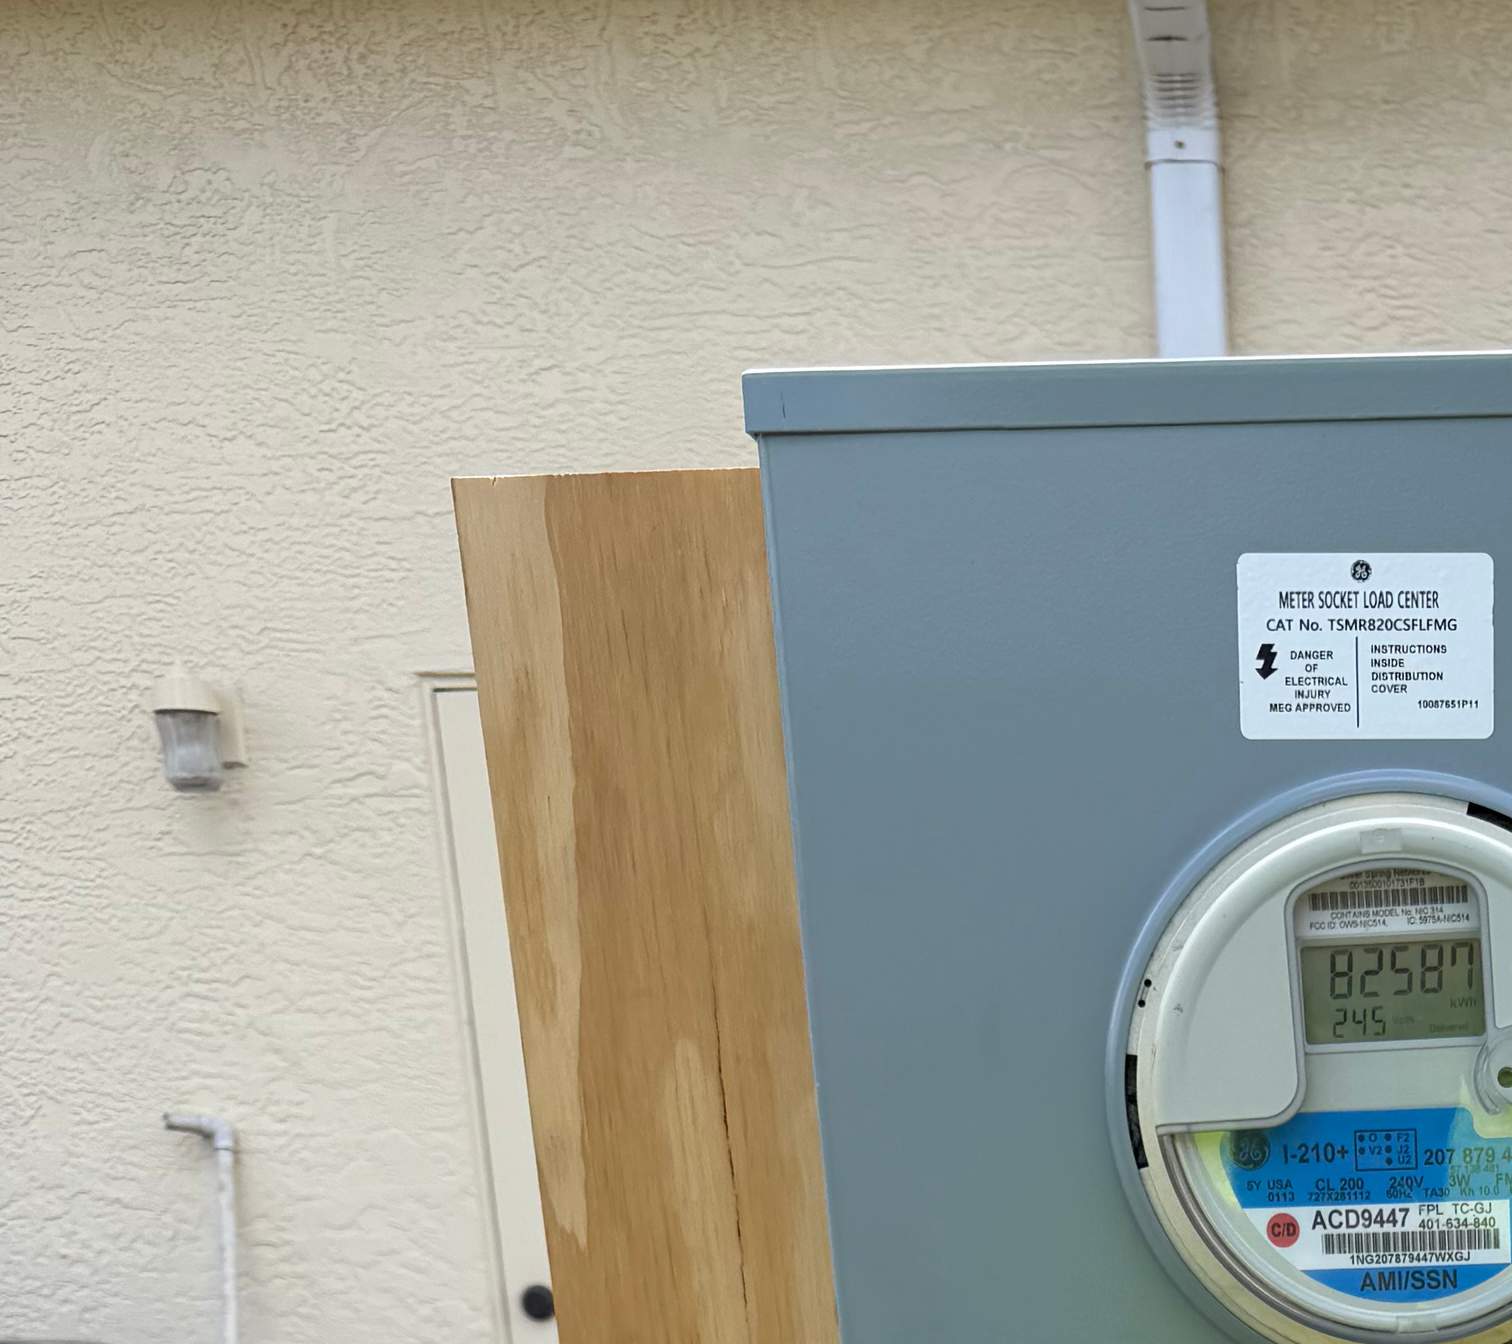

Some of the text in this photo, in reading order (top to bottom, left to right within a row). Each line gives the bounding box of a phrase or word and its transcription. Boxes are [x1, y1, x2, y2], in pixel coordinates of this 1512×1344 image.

[1278, 591, 1440, 609] METER SOCKET LOAD CENTER
[1266, 618, 1458, 632] CAT No. TSMR820CSFLFMG
[1290, 650, 1333, 660] DANGER
[1370, 644, 1447, 654] INSTRUCTIONS
[1305, 664, 1318, 673] OF
[1370, 658, 1405, 668] INSIDE
[1285, 676, 1348, 686] ELECTRICAL
[1371, 672, 1443, 681] DISTRIBUTION
[1294, 690, 1331, 699] INJURY
[1371, 685, 1408, 694] COVER
[1269, 703, 1351, 713] MEG APPROVED
[1329, 941, 1474, 1000] 82587
[1332, 1006, 1386, 1038] 245
[1283, 1142, 1349, 1164] I-210+
[1424, 1148, 1457, 1166] 207
[1462, 1146, 1496, 1164] 879
[1267, 1179, 1293, 1190] USA
[1315, 1178, 1335, 1191] CL
[1340, 1178, 1364, 1190] 200
[1389, 1175, 1424, 1189] 240V
[1450, 1174, 1471, 1187] 3W
[1424, 1186, 1450, 1198] TA30
[1418, 1202, 1493, 1216] FPL TC-GJ
[1311, 1208, 1410, 1231] ACD9447
[1418, 1216, 1496, 1230] 401-634-840
[1271, 1222, 1297, 1237] C/D
[1349, 1251, 1471, 1266] 1NG207879447WXGJ
[1360, 1269, 1458, 1291] AMI/SSN
